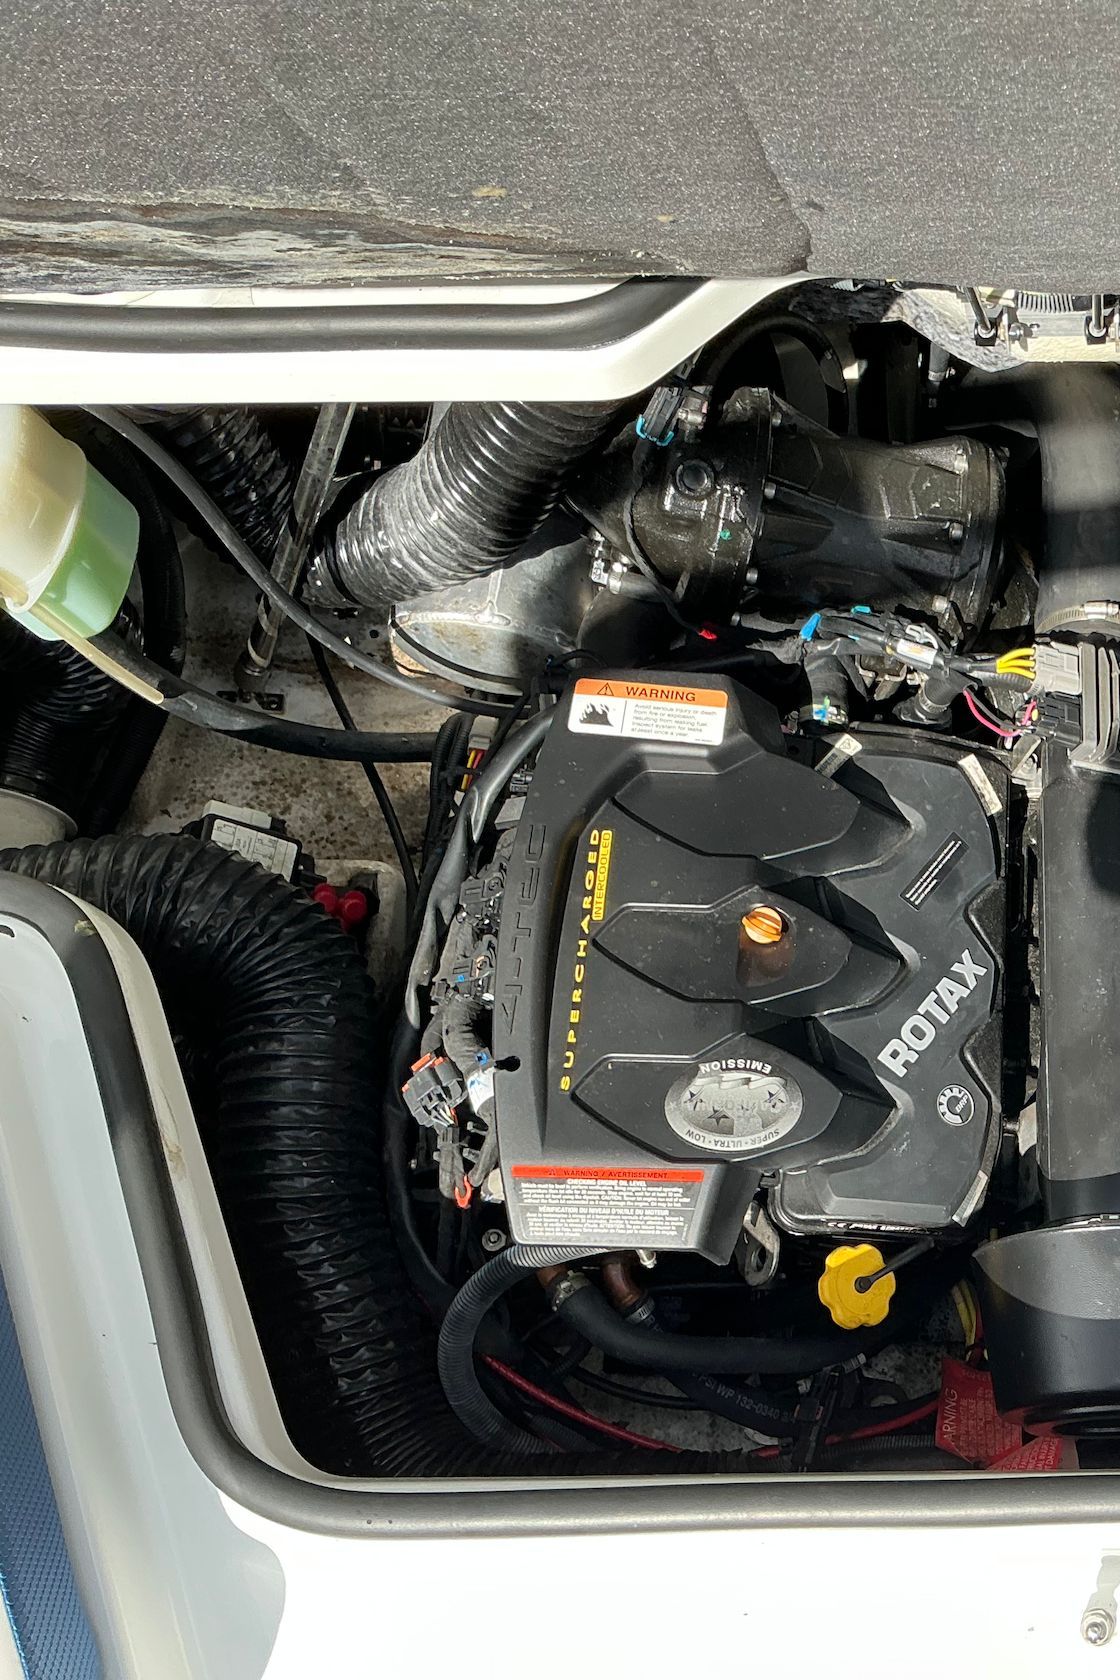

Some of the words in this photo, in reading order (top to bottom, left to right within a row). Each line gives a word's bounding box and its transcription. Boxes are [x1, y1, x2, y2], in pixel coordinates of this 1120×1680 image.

[625, 686, 696, 702] WARNING
[594, 831, 612, 919] INTERCOOLED
[560, 829, 600, 1092] SUPERCHARGED
[877, 949, 988, 1078] ROTAX
[699, 1058, 772, 1075] EMISSION
[685, 1128, 706, 1144] LOW
[713, 1138, 742, 1148] ULTRA
[750, 1128, 780, 1146] SUPER
[608, 1170, 668, 1179] AVERTISSEMENT
[716, 1383, 735, 1399] WP
[942, 1388, 958, 1445] ARNING
